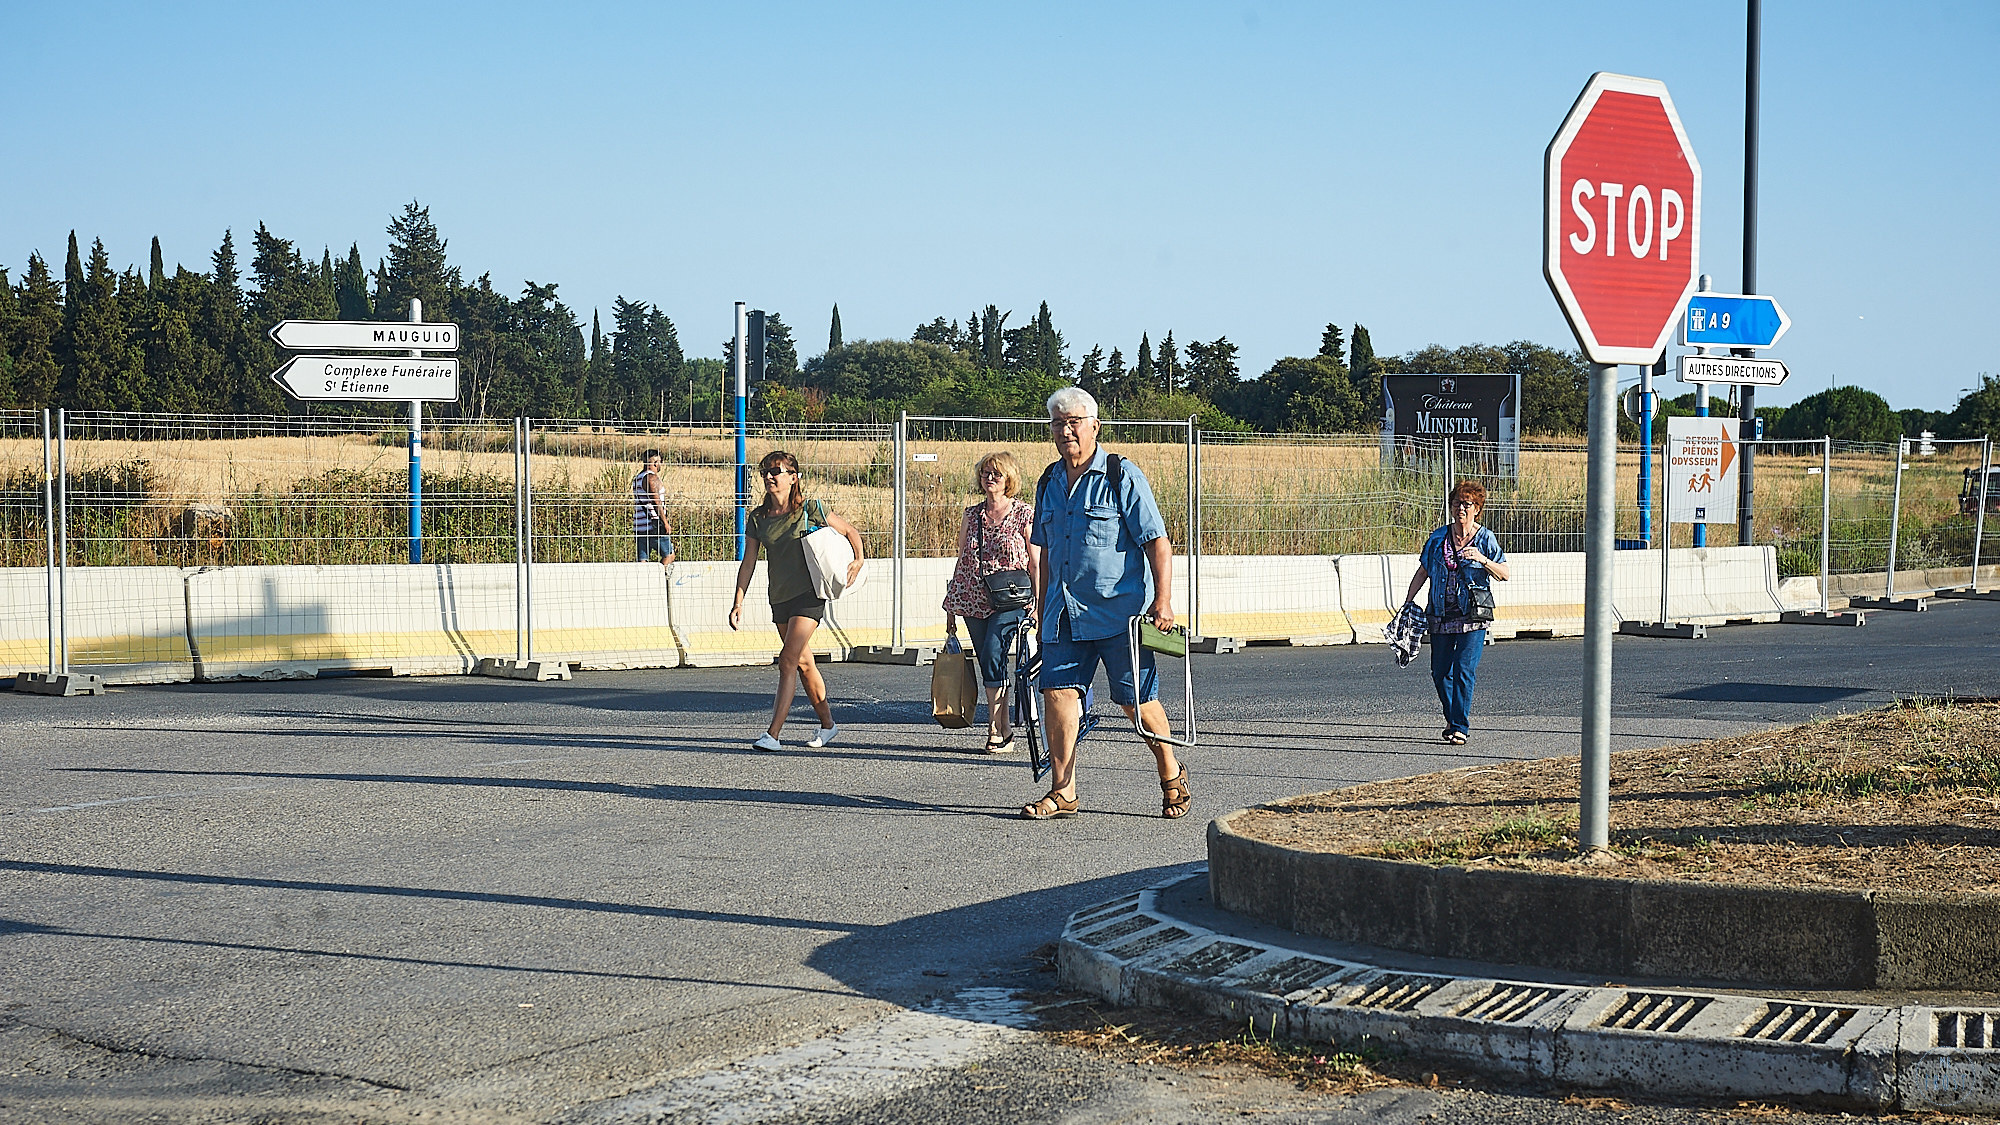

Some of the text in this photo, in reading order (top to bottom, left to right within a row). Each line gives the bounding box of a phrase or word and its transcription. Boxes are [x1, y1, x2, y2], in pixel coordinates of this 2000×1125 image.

[1569, 178, 1685, 261] STOP
[373, 330, 451, 343] MAUGUIO
[324, 364, 451, 379] Complexe Funéraire
[1688, 363, 1776, 378] AUTRES DIRECTIONS
[340, 377, 390, 393] Étienne
[1421, 394, 1473, 410] Château
[1415, 411, 1479, 434] MINISTRE
[1682, 445, 1718, 456] PIÉTONS
[1671, 456, 1718, 466] ODYSSEUM
